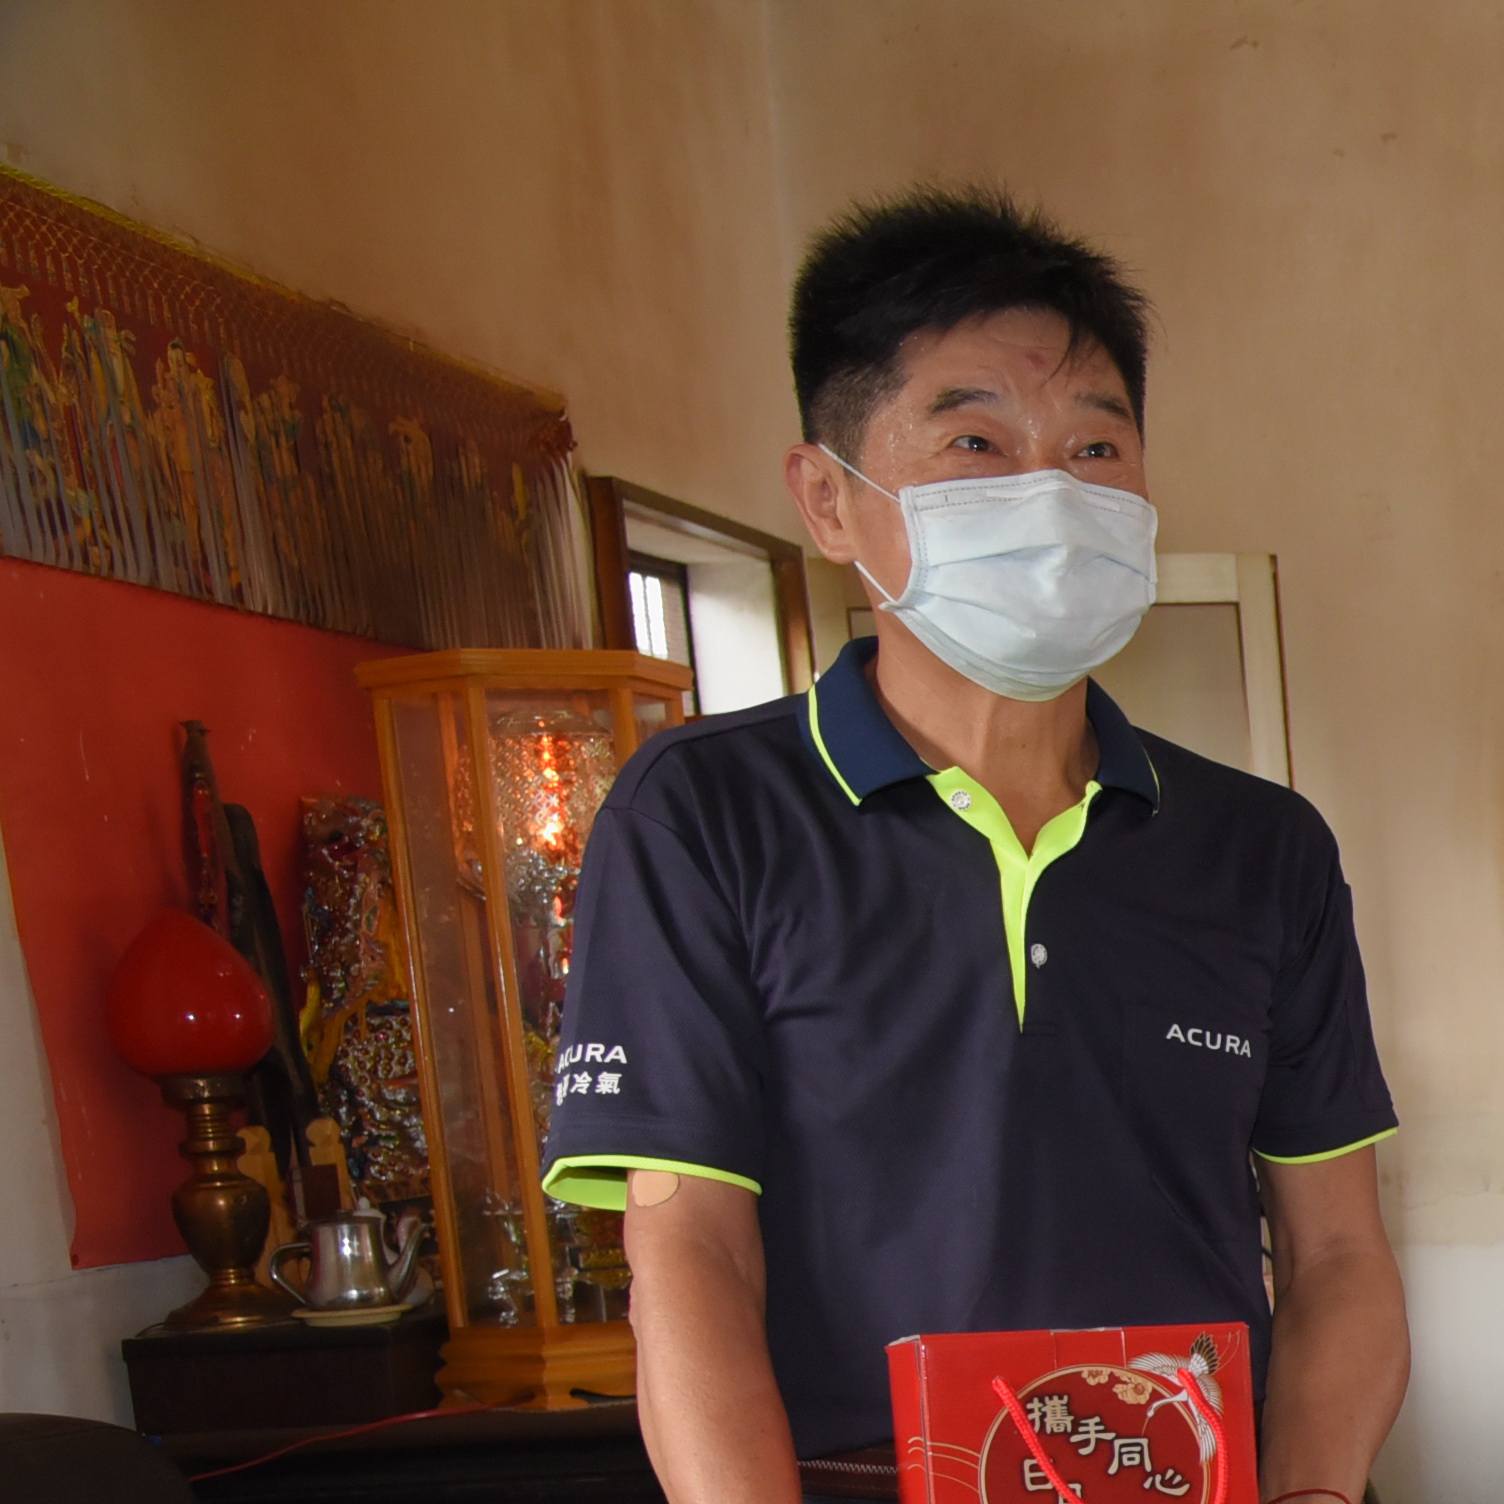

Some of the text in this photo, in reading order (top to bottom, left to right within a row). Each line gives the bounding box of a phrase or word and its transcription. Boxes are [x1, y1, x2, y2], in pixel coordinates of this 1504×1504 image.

[1166, 1023, 1251, 1058] ACURA
[1026, 1395, 1190, 1496] 攜手同心
